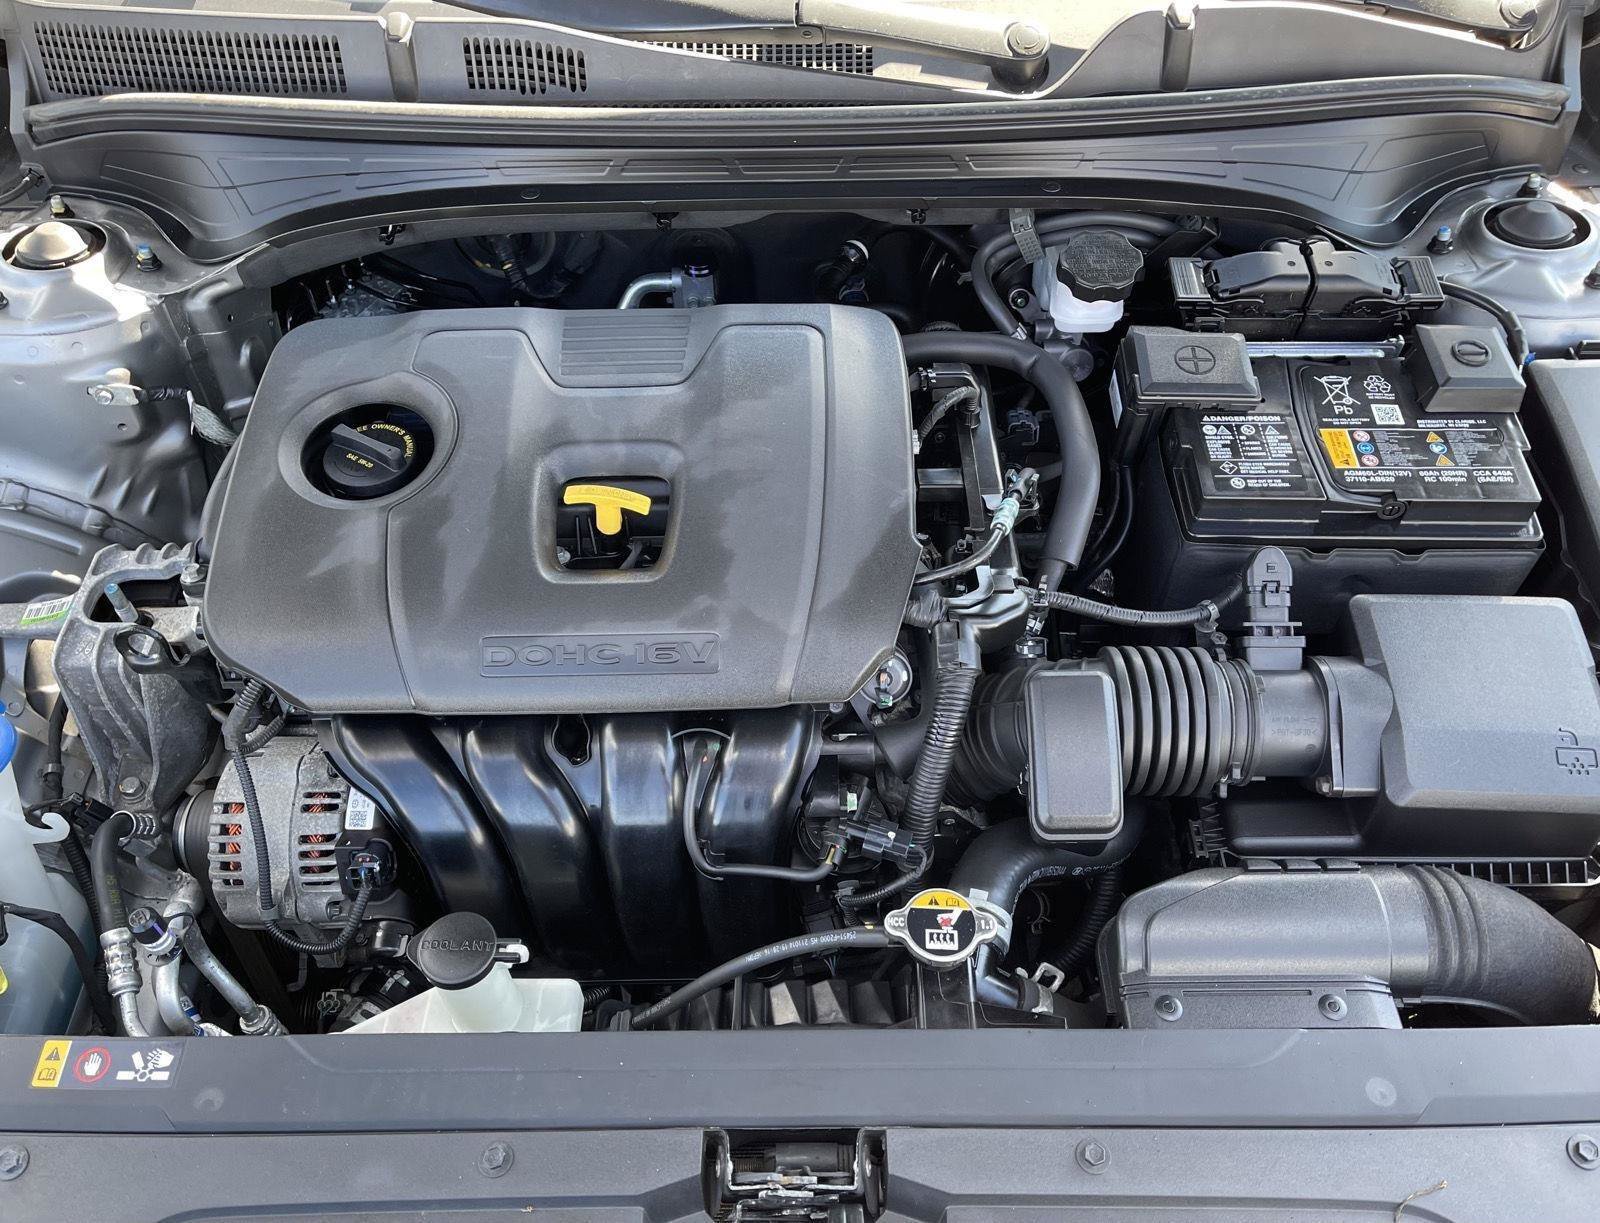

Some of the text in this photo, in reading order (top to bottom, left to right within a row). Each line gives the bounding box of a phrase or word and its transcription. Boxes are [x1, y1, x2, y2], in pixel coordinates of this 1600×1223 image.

[1333, 405, 1353, 415] Pb
[371, 423, 405, 436] OWNER'S
[403, 434, 414, 458] MANUAL
[484, 641, 716, 667] DOHC 16V
[888, 917, 993, 930] HCC 1.1
[420, 939, 494, 952] COOLANT
